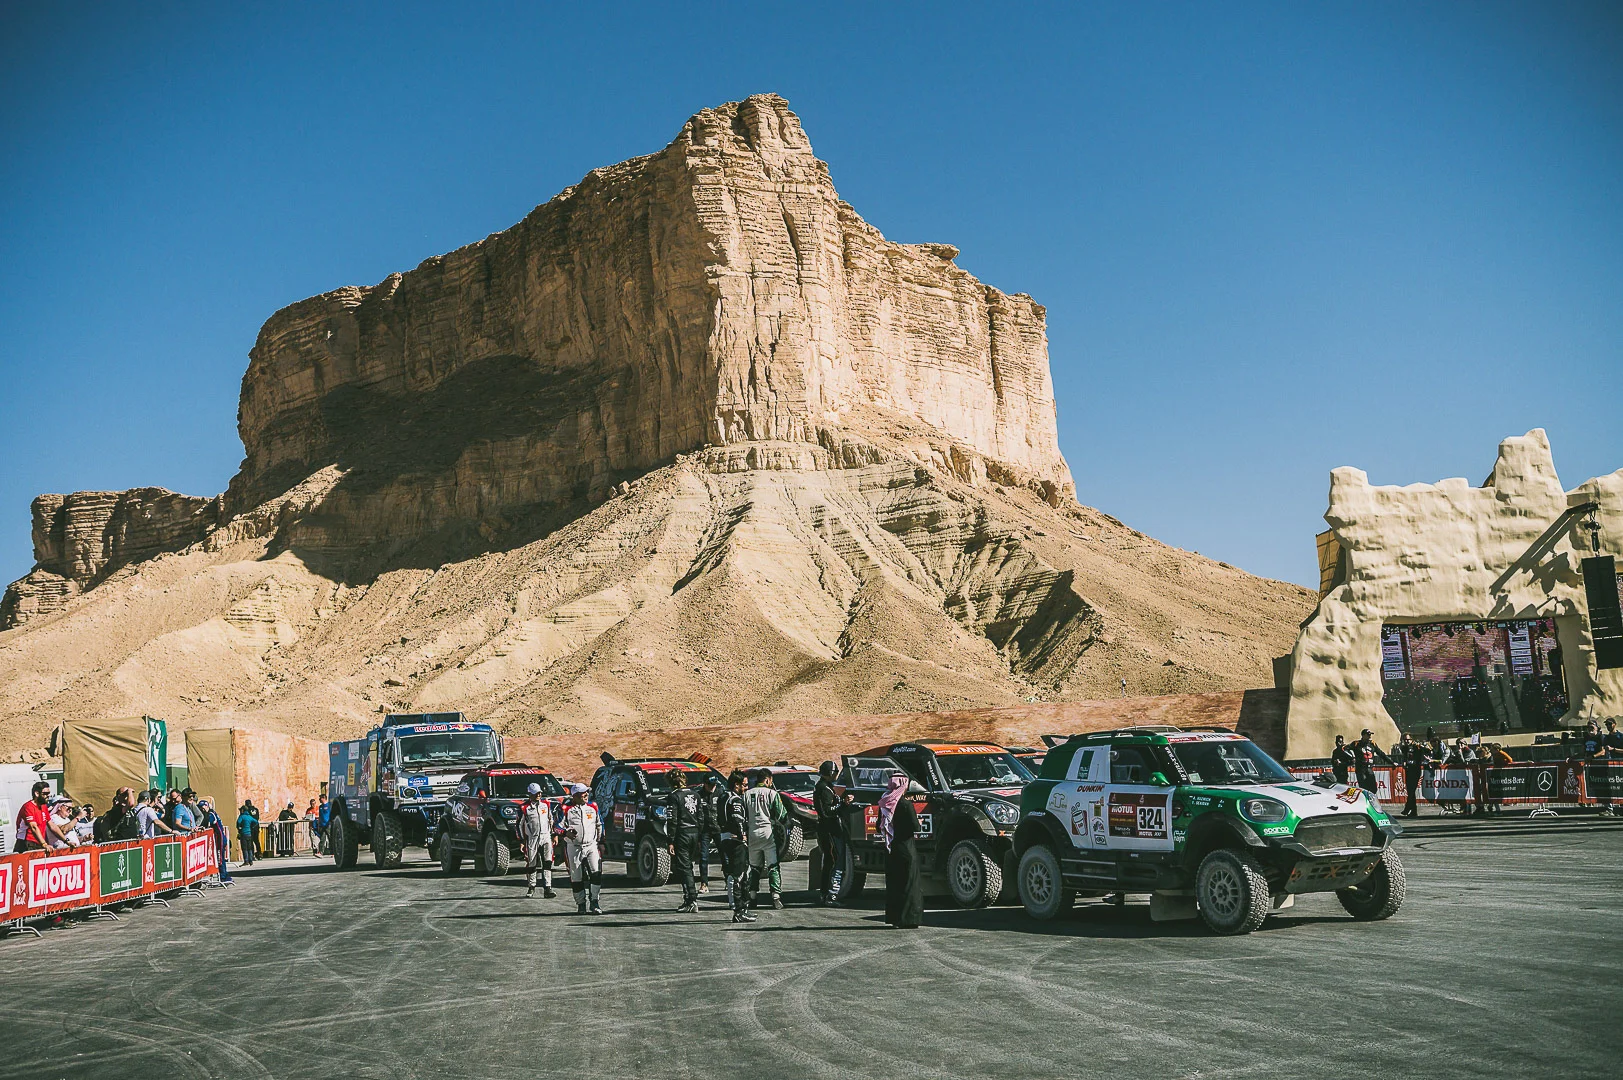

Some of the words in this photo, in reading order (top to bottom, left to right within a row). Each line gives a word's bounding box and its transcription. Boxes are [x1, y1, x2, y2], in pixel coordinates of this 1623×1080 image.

[1425, 780, 1469, 788] HONDA
[625, 814, 634, 828] 312
[1139, 808, 1164, 829] 324
[1263, 826, 1289, 835] sparco
[36, 865, 84, 896] MOTUL
